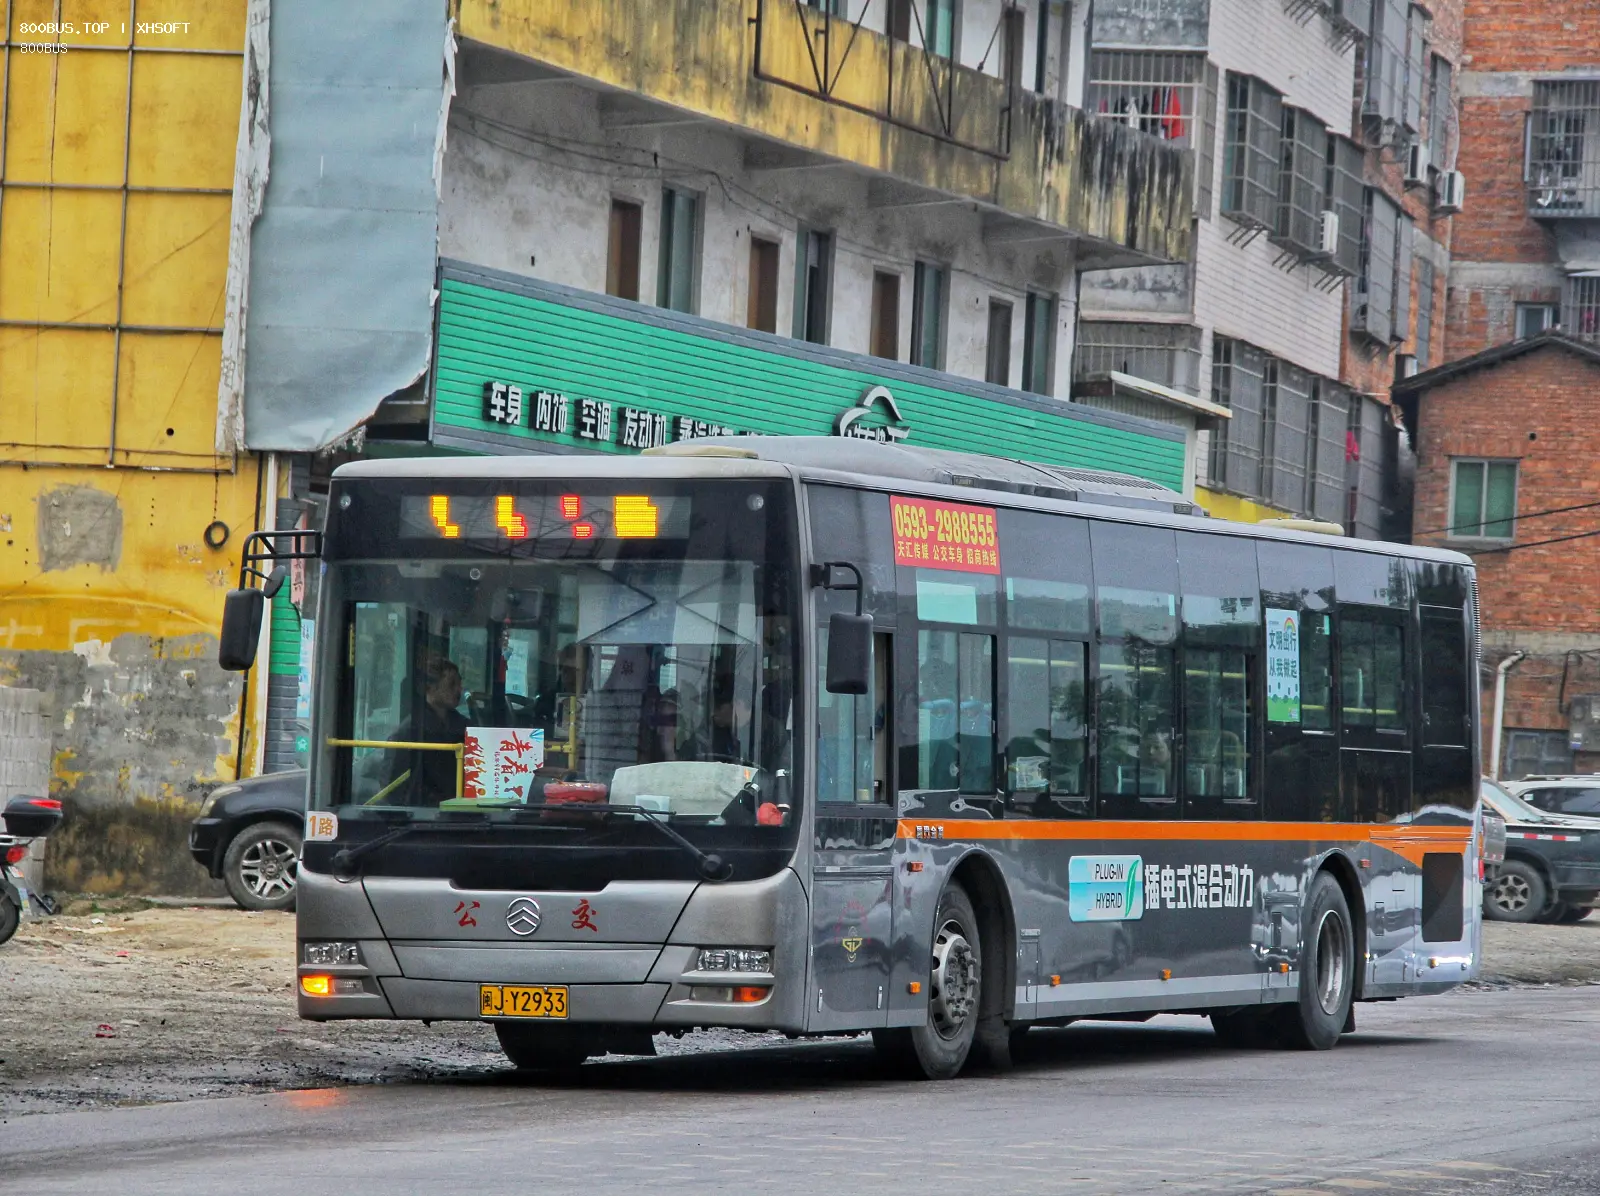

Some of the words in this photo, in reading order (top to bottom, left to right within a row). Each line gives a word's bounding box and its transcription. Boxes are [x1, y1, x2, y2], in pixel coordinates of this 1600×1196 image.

[489, 381, 522, 425] 车身
[535, 390, 568, 433] 内饰
[579, 398, 612, 442] 空调
[622, 406, 667, 447] 发动机
[894, 503, 996, 547] 0593-2988555
[897, 540, 930, 560] 天汇传媒
[932, 544, 963, 564] 公交车身
[966, 547, 997, 567] 招商热线
[1268, 629, 1297, 652] 文明出行
[1268, 657, 1298, 679] 从我做起
[1094, 862, 1124, 881] PLUG-IN
[1144, 863, 1254, 910] 插电式混合动力
[1095, 892, 1123, 909] HYBRID
